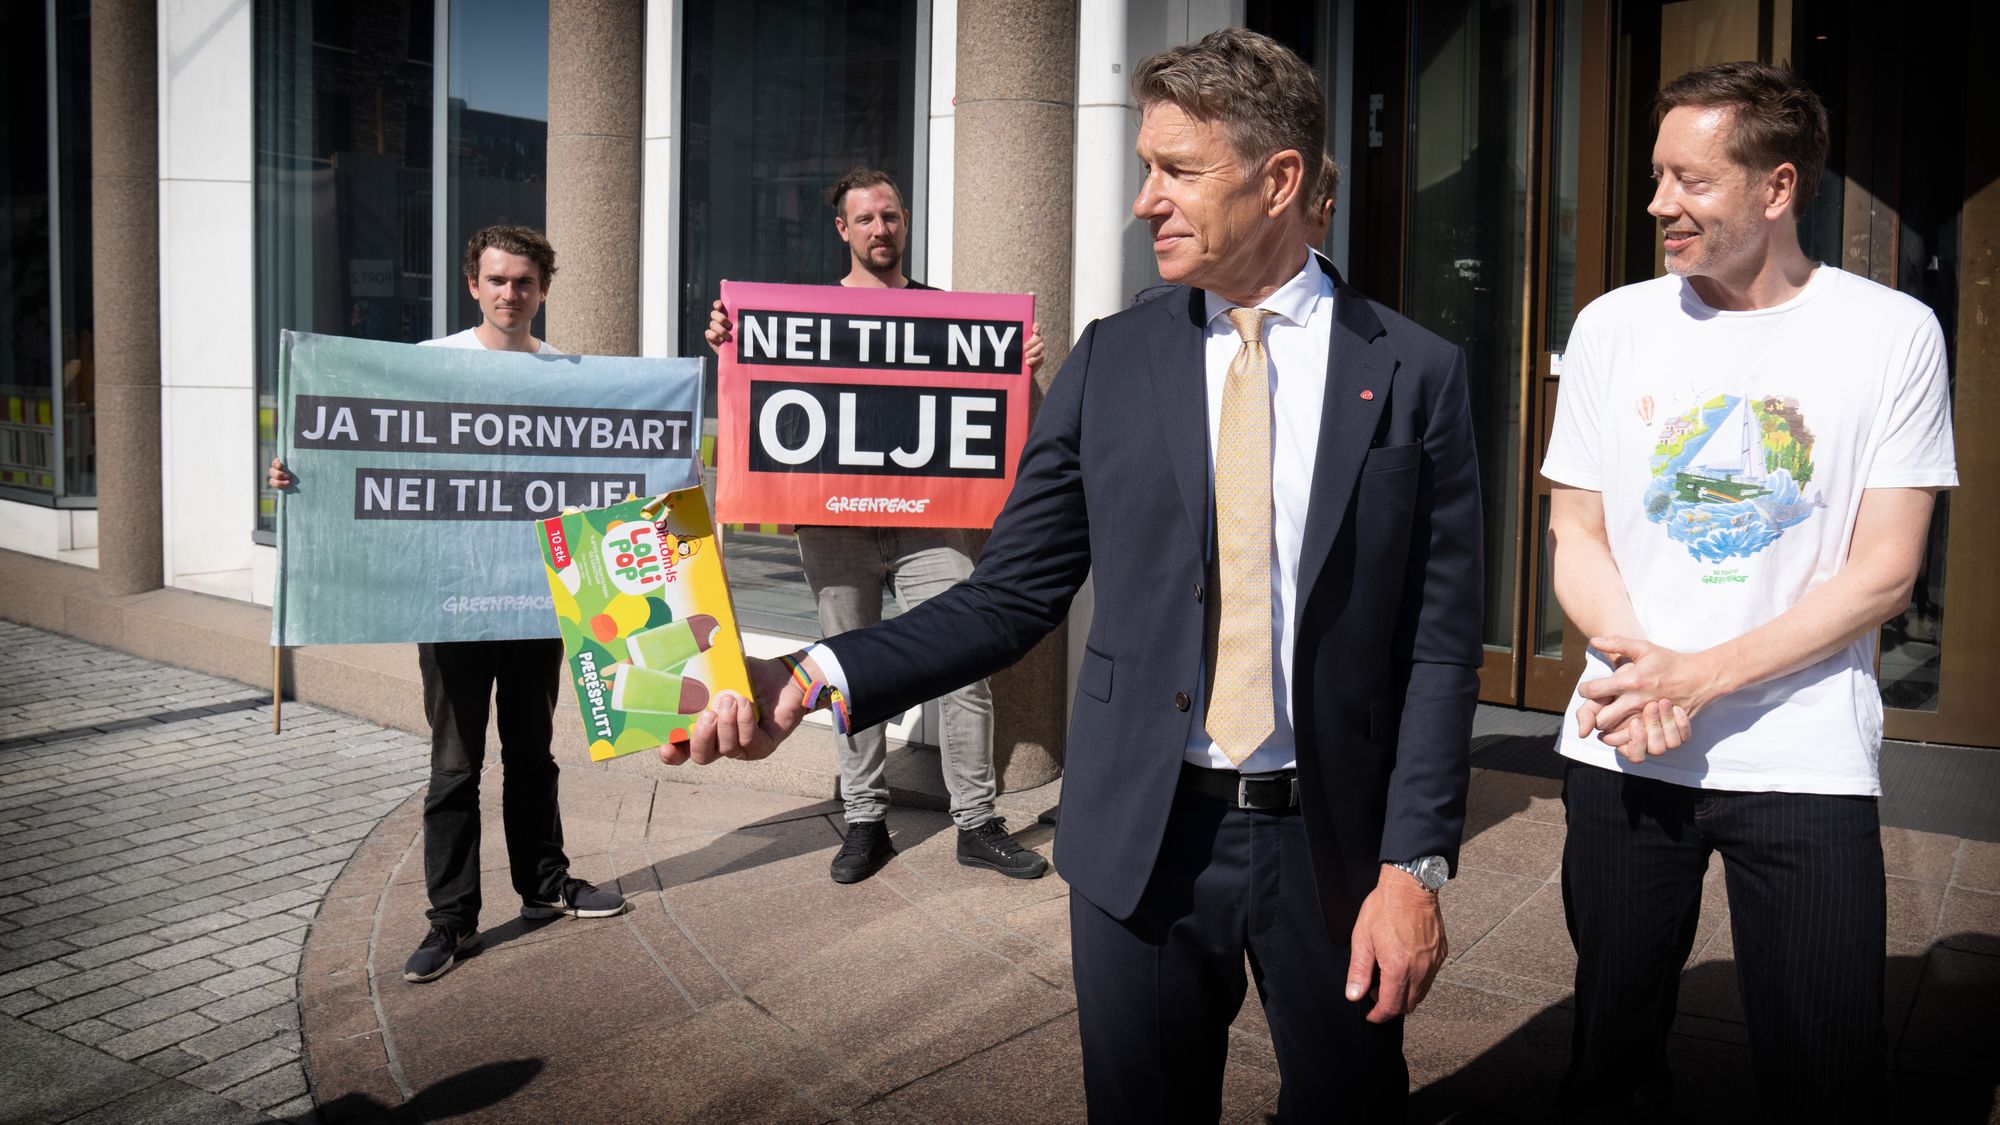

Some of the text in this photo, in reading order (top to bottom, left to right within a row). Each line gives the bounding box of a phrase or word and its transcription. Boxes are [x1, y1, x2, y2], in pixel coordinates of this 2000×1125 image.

[743, 315, 1017, 367] NEI TIL NY
[301, 406, 688, 451] JA TIL FORNYBART
[758, 389, 997, 470] OLJE
[363, 477, 436, 511] NEI
[449, 479, 513, 512] TIL
[825, 496, 931, 514] GREENPEACE
[551, 530, 567, 563] 10 stk
[442, 595, 554, 614] GREENPEACE
